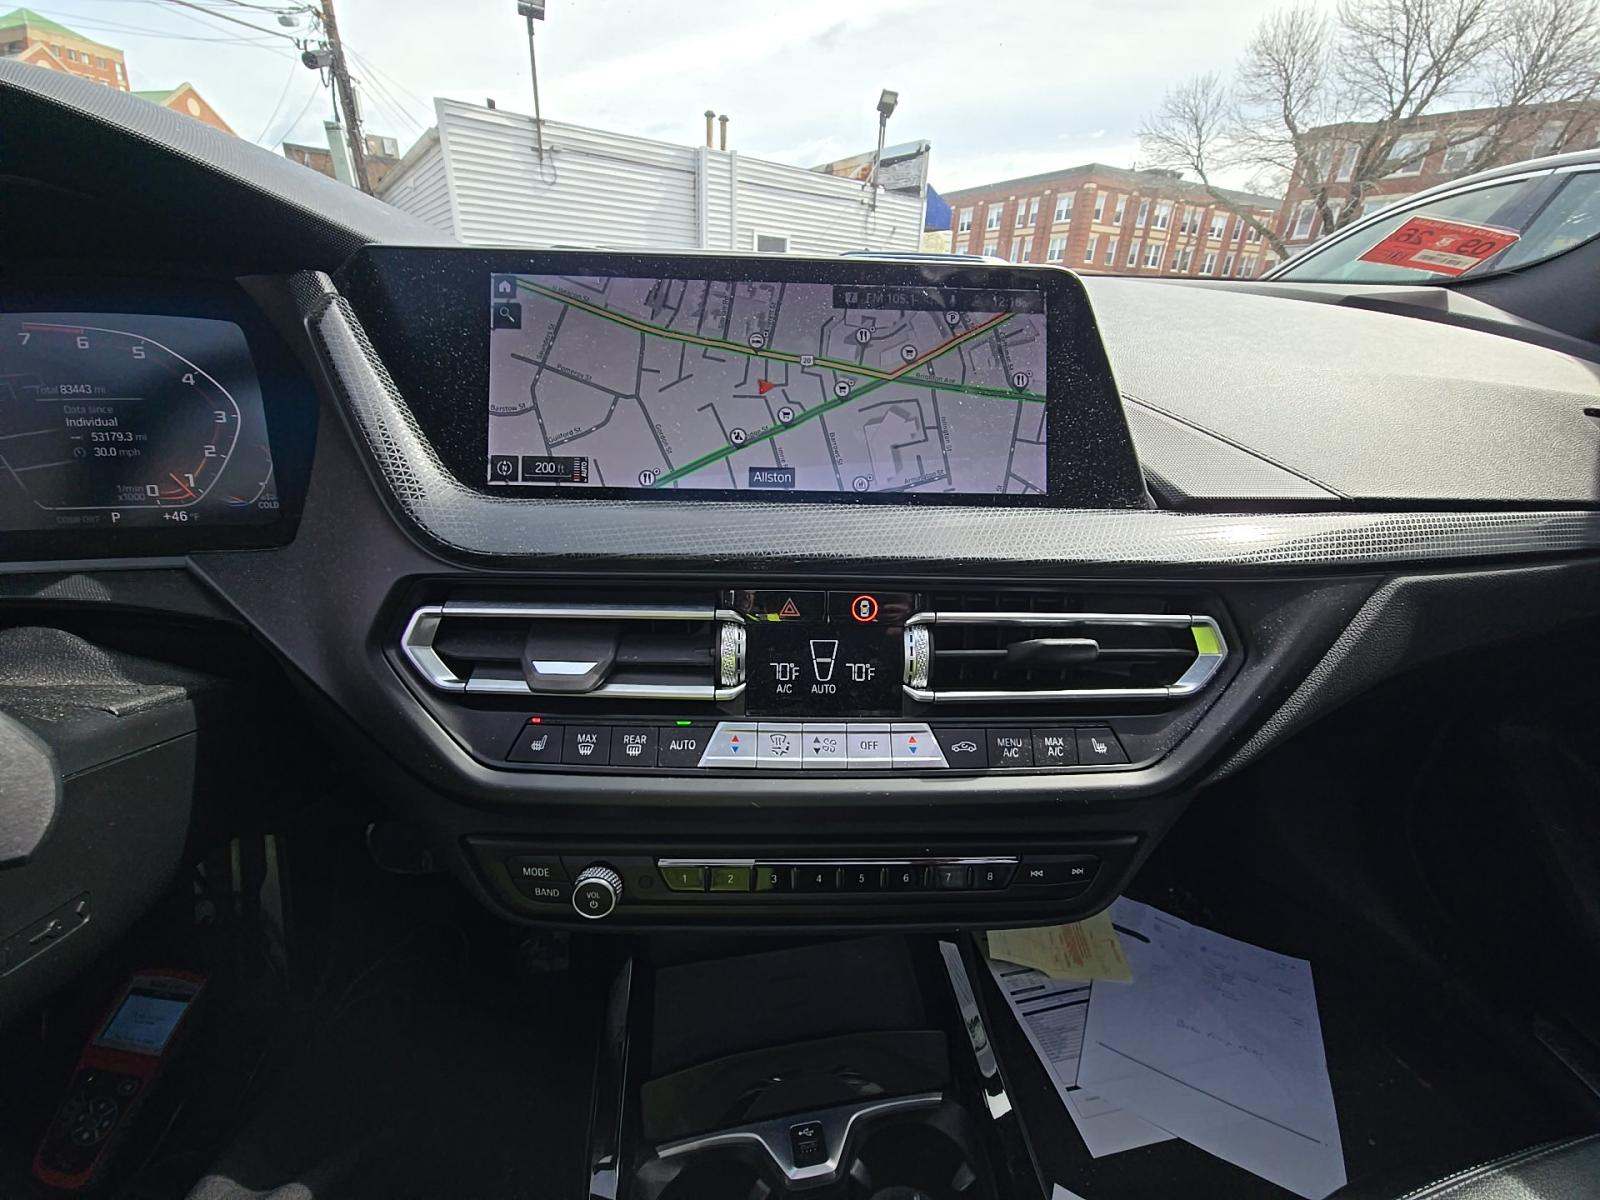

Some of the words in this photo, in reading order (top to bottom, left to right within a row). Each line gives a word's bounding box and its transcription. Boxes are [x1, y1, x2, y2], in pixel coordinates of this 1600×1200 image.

[18, 333, 31, 345] 7
[76, 337, 90, 349] 6
[132, 346, 146, 359] 5
[181, 373, 196, 386] 4
[60, 384, 92, 395] 83443
[64, 405, 86, 414] Data
[65, 417, 118, 428] Individual
[213, 411, 226, 423] 3
[91, 432, 133, 442] 53179.3
[94, 447, 117, 457] 30.0
[204, 445, 216, 457] 2
[535, 462, 556, 473] 200
[184, 474, 195, 487] 1
[753, 471, 792, 483] Allston
[146, 485, 159, 497] 0
[258, 501, 279, 509] COLD
[111, 512, 121, 523] P
[163, 511, 188, 521] +46
[776, 684, 793, 694] A/C
[811, 684, 837, 694] AUTO
[577, 734, 597, 743] MAX
[623, 734, 647, 744] REAR
[997, 737, 1022, 747] MENU
[1044, 737, 1063, 747] MAX
[669, 739, 696, 750] AUTO
[860, 740, 878, 751] OFF
[1003, 747, 1019, 758] A/C
[1048, 747, 1064, 757] A/C
[522, 867, 550, 877] MODE
[534, 887, 560, 898] BAND
[586, 891, 600, 899] VOL
